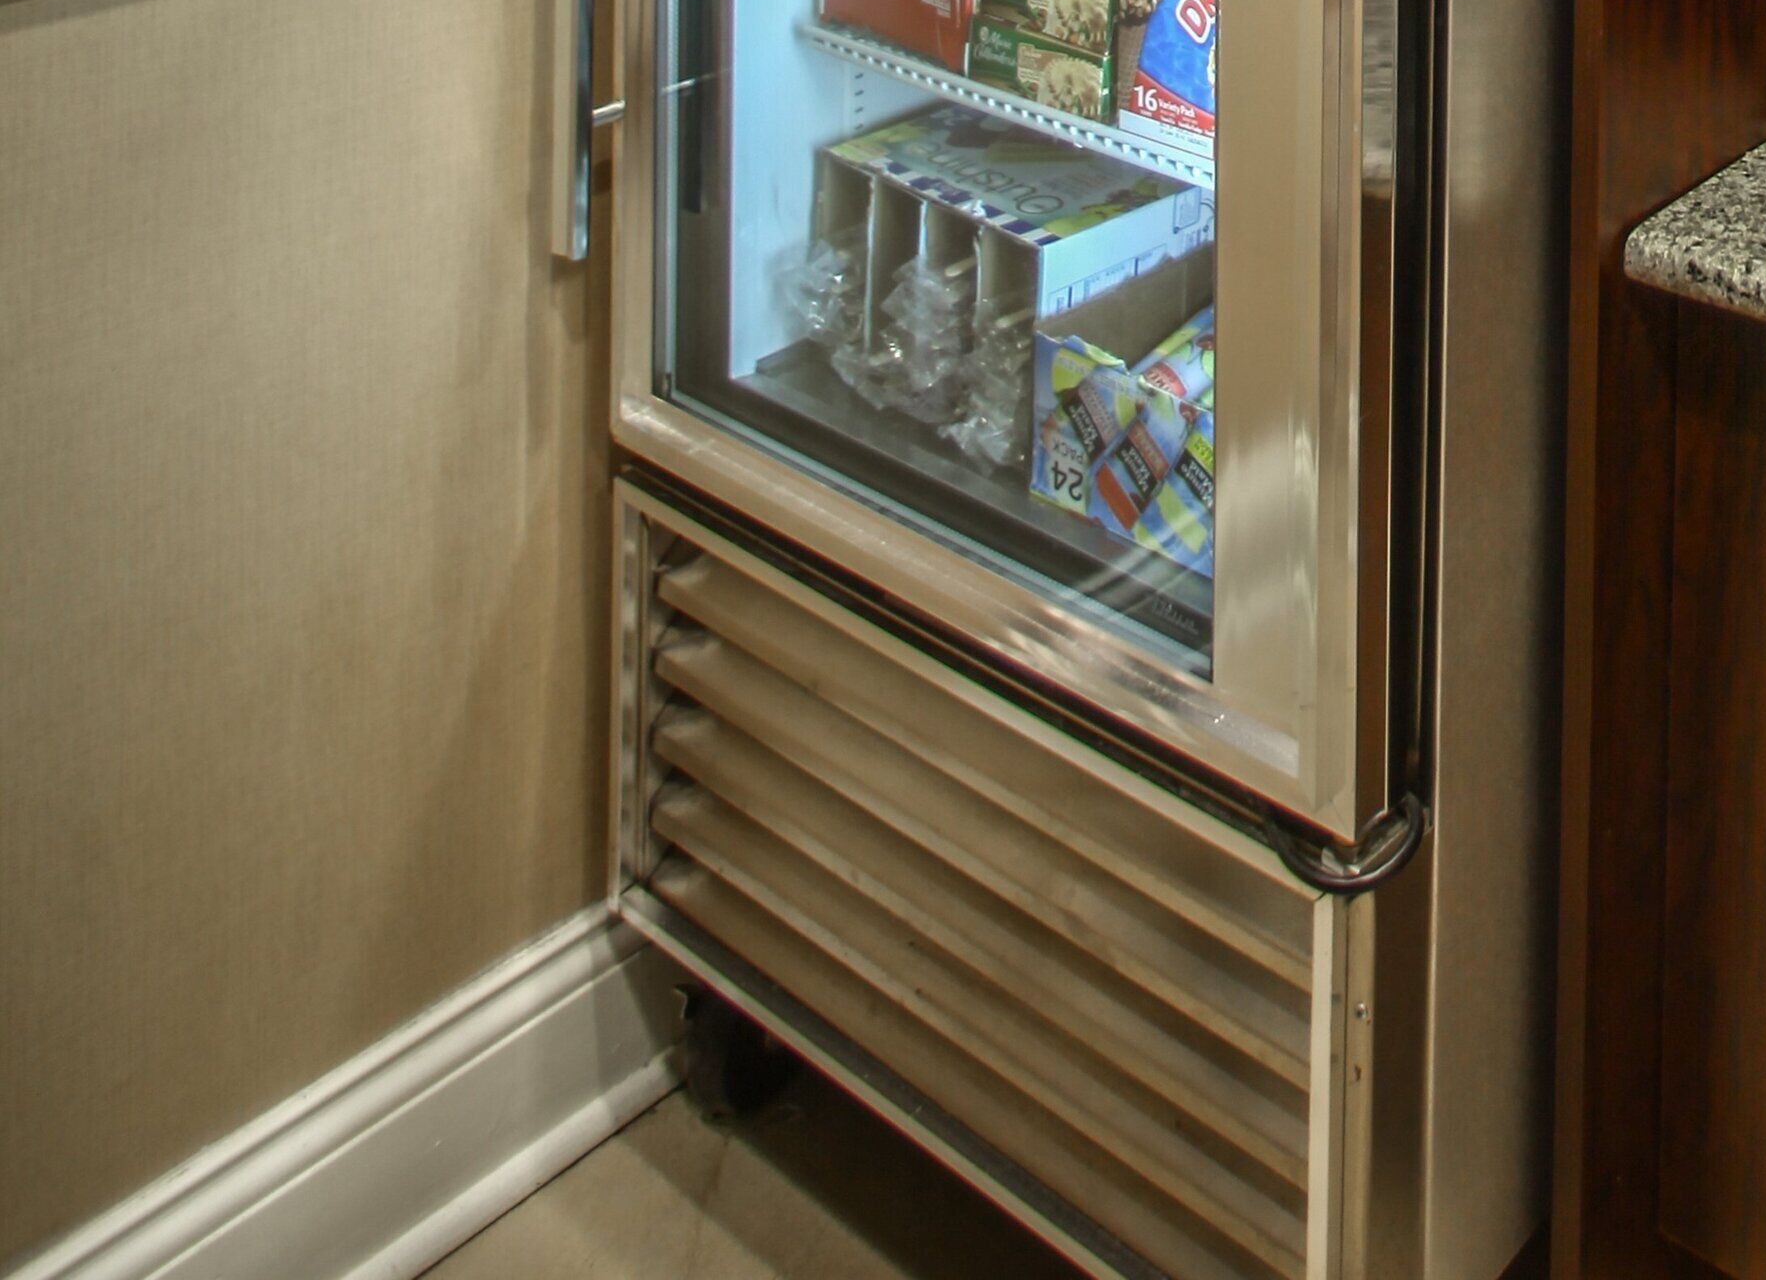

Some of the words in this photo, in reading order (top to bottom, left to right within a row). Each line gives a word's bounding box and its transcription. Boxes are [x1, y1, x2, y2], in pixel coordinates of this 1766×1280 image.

[1134, 86, 1158, 111] 16
[1052, 438, 1085, 465] PACK
[1052, 461, 1083, 502] 24
